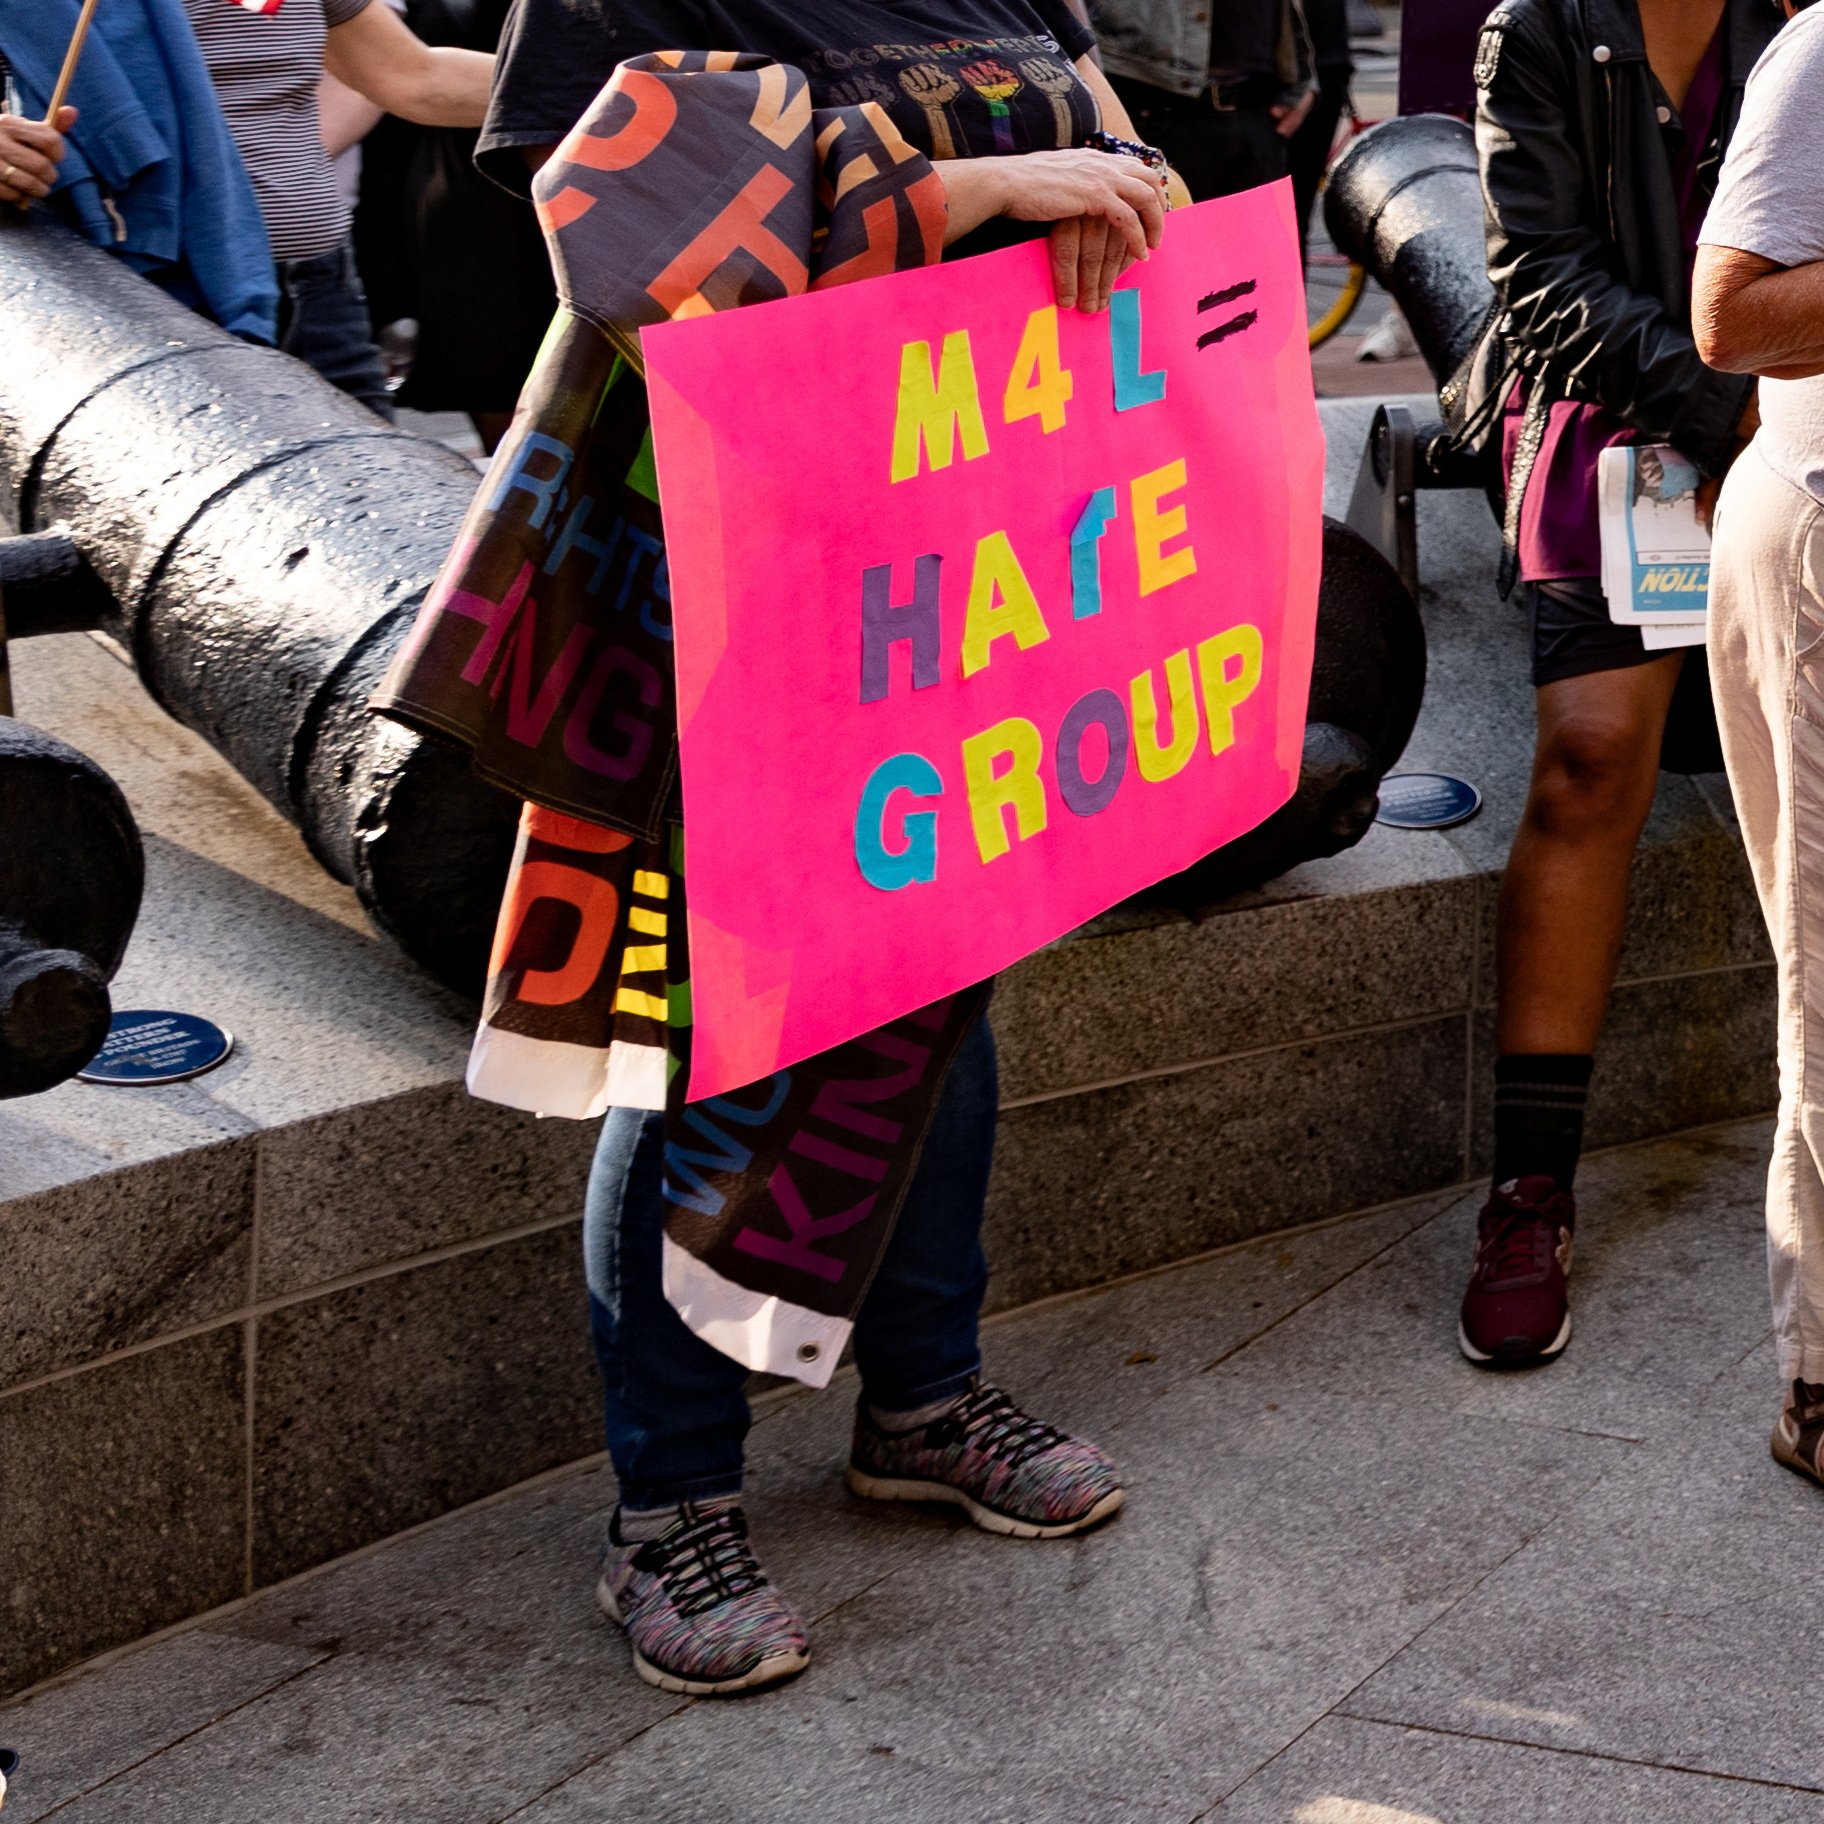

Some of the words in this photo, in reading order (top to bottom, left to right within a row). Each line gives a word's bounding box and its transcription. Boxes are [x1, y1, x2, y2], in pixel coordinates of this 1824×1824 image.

[890, 286, 1167, 484] M4L
[858, 456, 1198, 706] HATE
[852, 622, 1266, 893] GROUP
